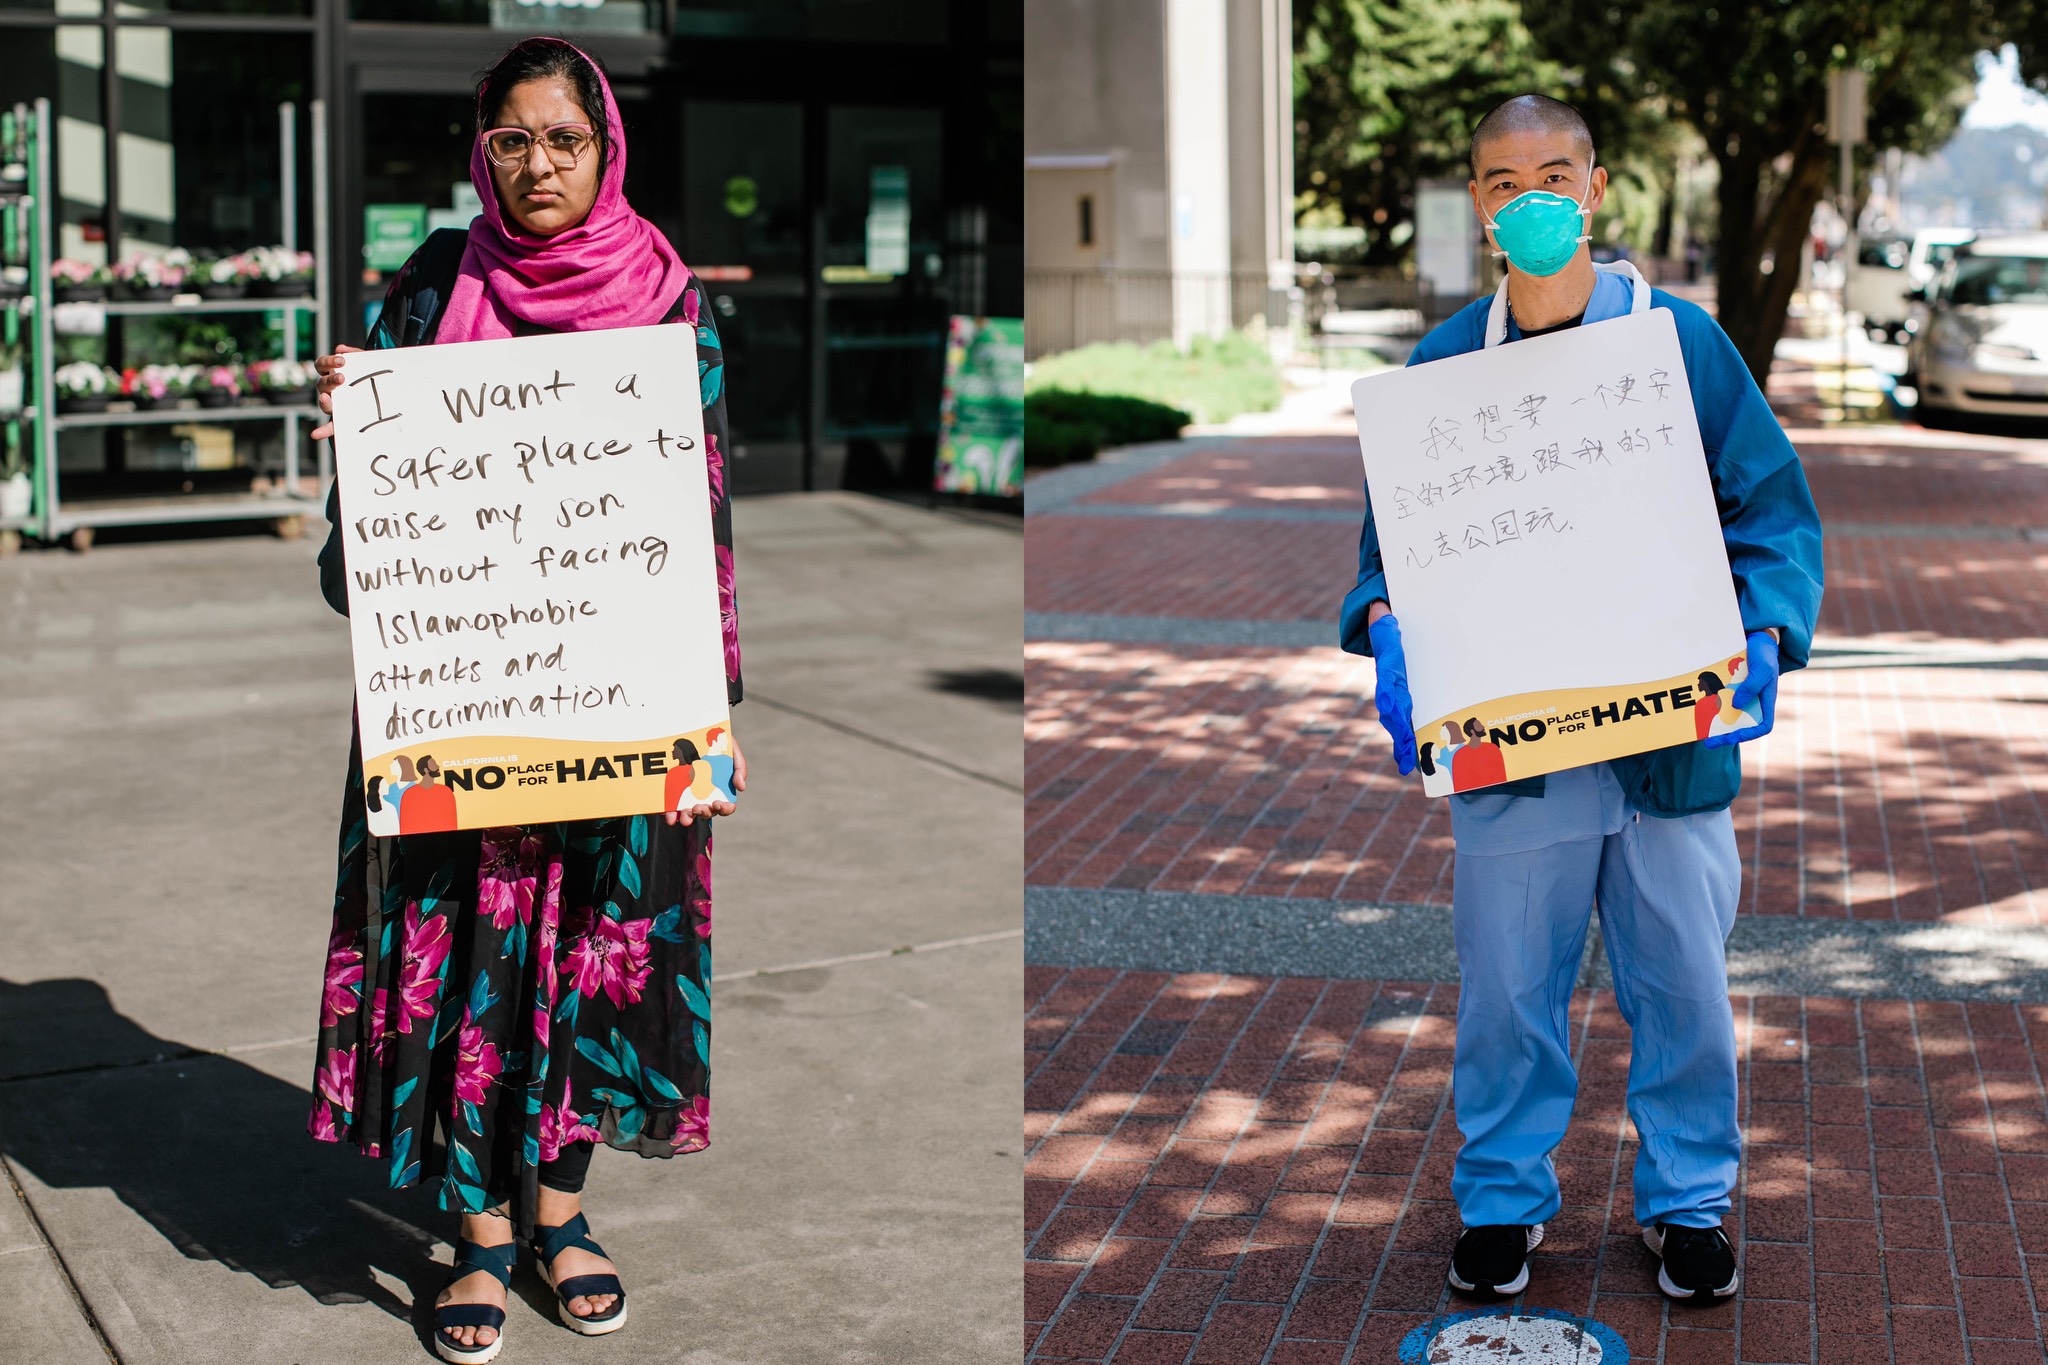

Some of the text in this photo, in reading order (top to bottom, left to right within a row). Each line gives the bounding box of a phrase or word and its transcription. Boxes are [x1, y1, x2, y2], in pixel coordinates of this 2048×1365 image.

[348, 369, 403, 434] I
[614, 373, 642, 400] a
[513, 435, 633, 484] place
[647, 428, 696, 459] to
[355, 491, 626, 545] raise my son
[354, 535, 669, 593] without facing
[375, 598, 598, 650] Islamophobic
[368, 642, 565, 694] attacks and
[385, 683, 645, 740] discrimination.
[1486, 706, 1556, 727] CALIFORNIA IS
[1488, 685, 1697, 748] NO PLACE FOR HATE
[442, 754, 518, 768] CALIFORNIA IS
[443, 751, 668, 792] NO PLACE FOR HATE
